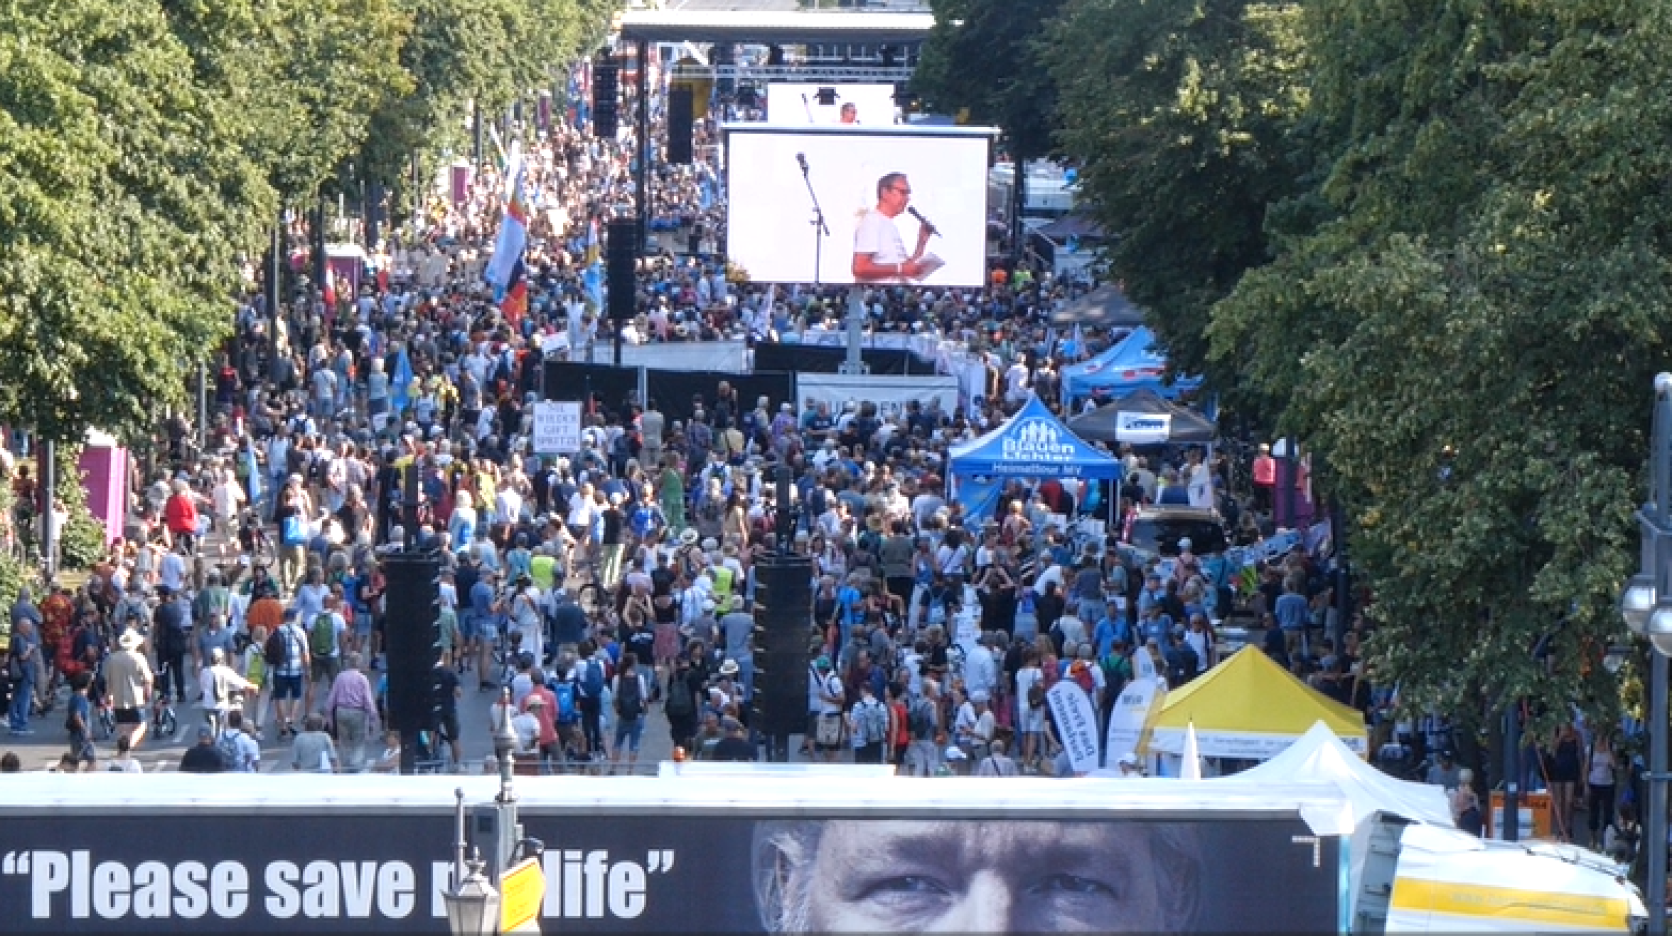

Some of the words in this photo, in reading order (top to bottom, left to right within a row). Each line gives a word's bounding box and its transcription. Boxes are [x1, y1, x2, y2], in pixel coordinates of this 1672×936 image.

[537, 414, 577, 424] WIEDER
[1002, 437, 1075, 452] Blauen
[264, 857, 415, 918] save
